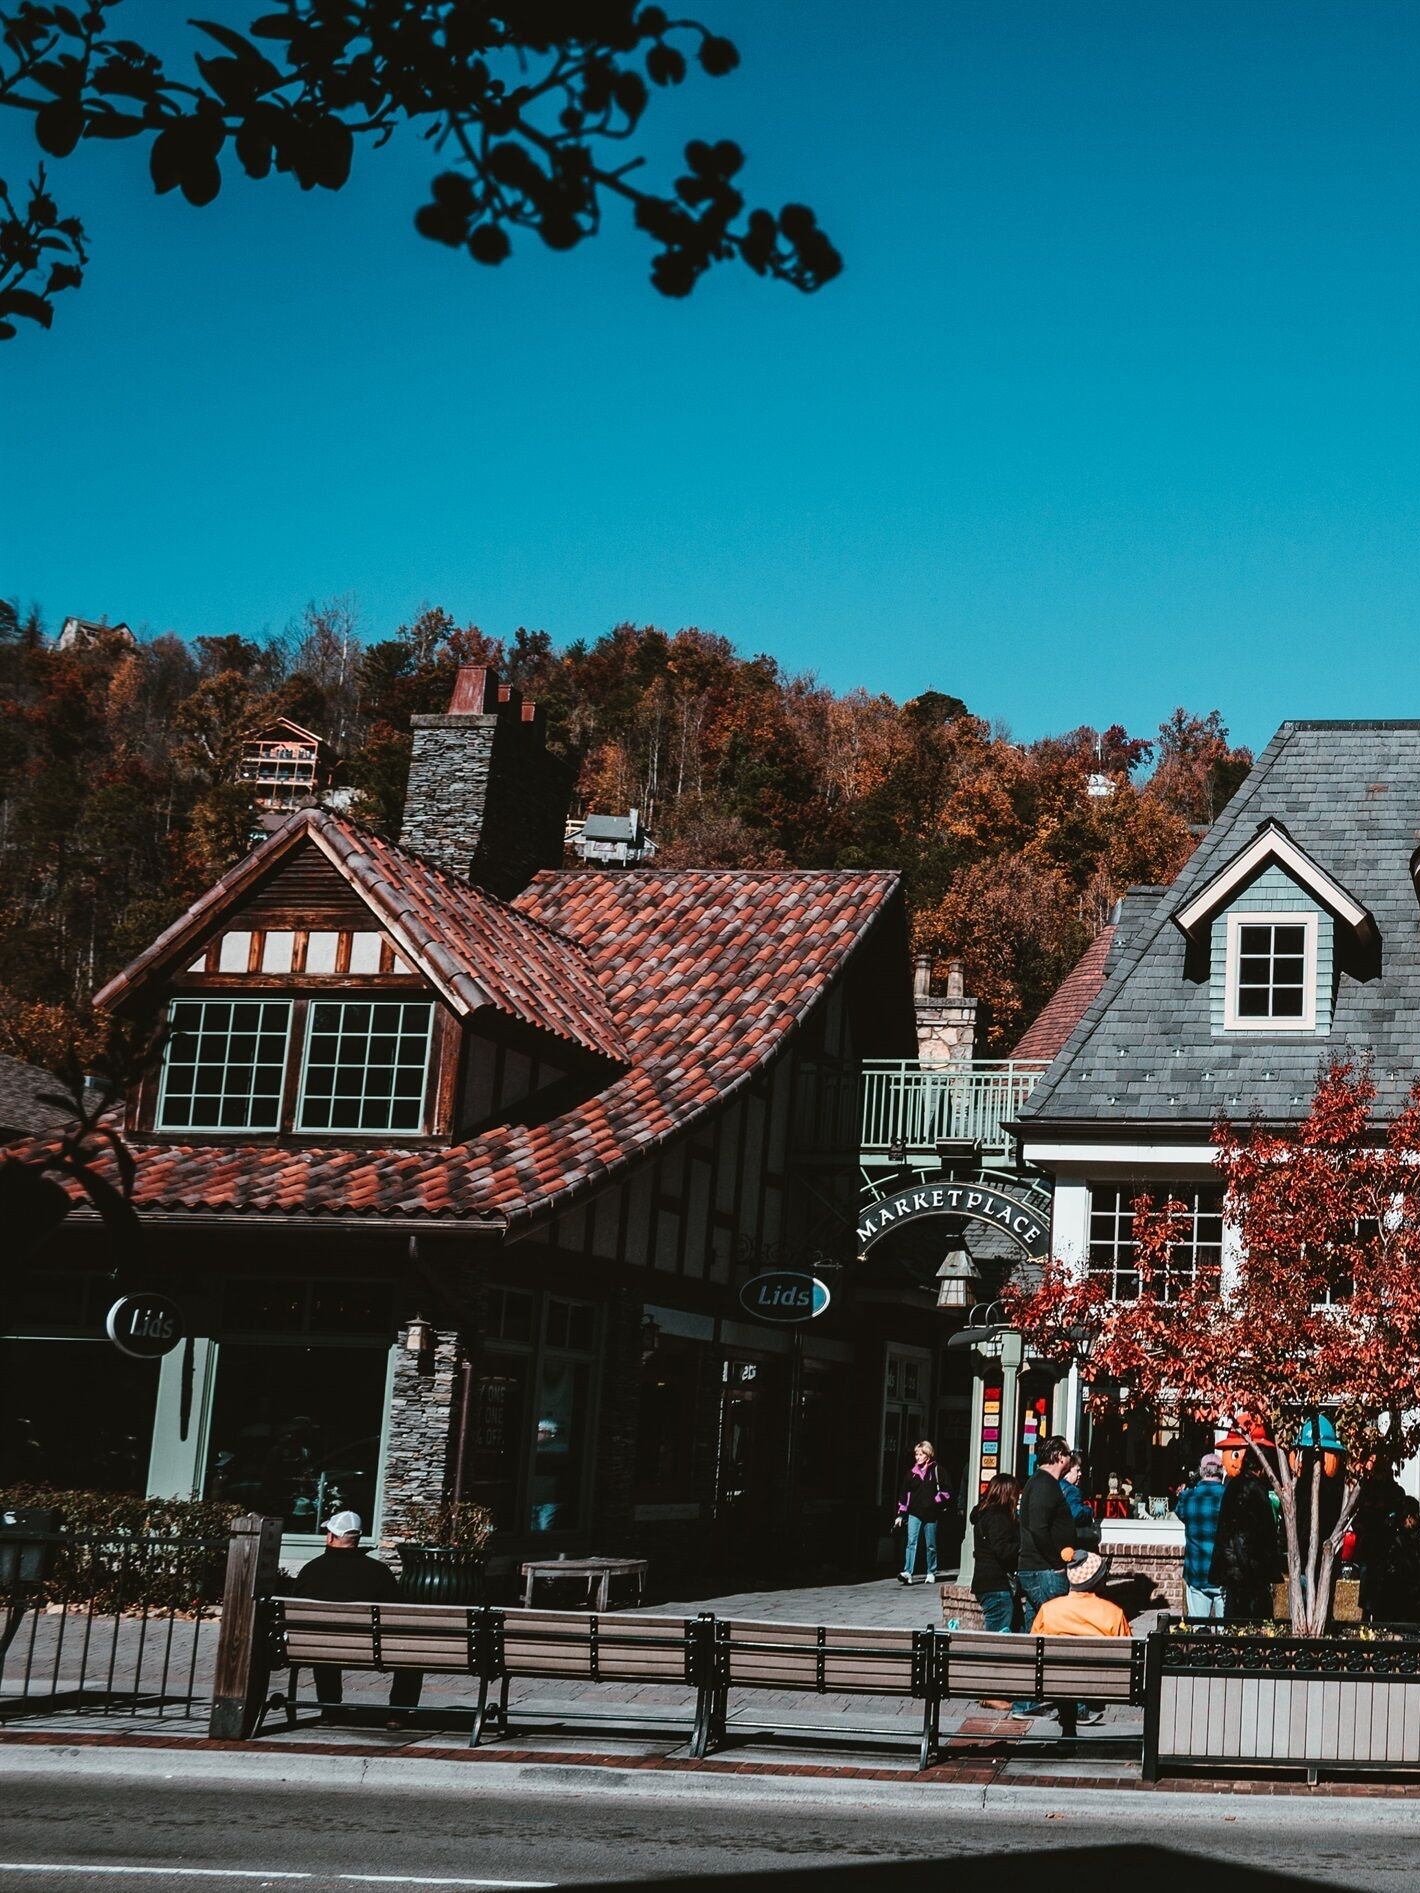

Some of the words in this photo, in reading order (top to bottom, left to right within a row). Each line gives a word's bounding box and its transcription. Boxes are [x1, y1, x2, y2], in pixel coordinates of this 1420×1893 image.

[856, 1190, 1041, 1243] MARKETPLACE
[758, 1286, 810, 1306] Lids
[130, 1309, 173, 1338] Lids
